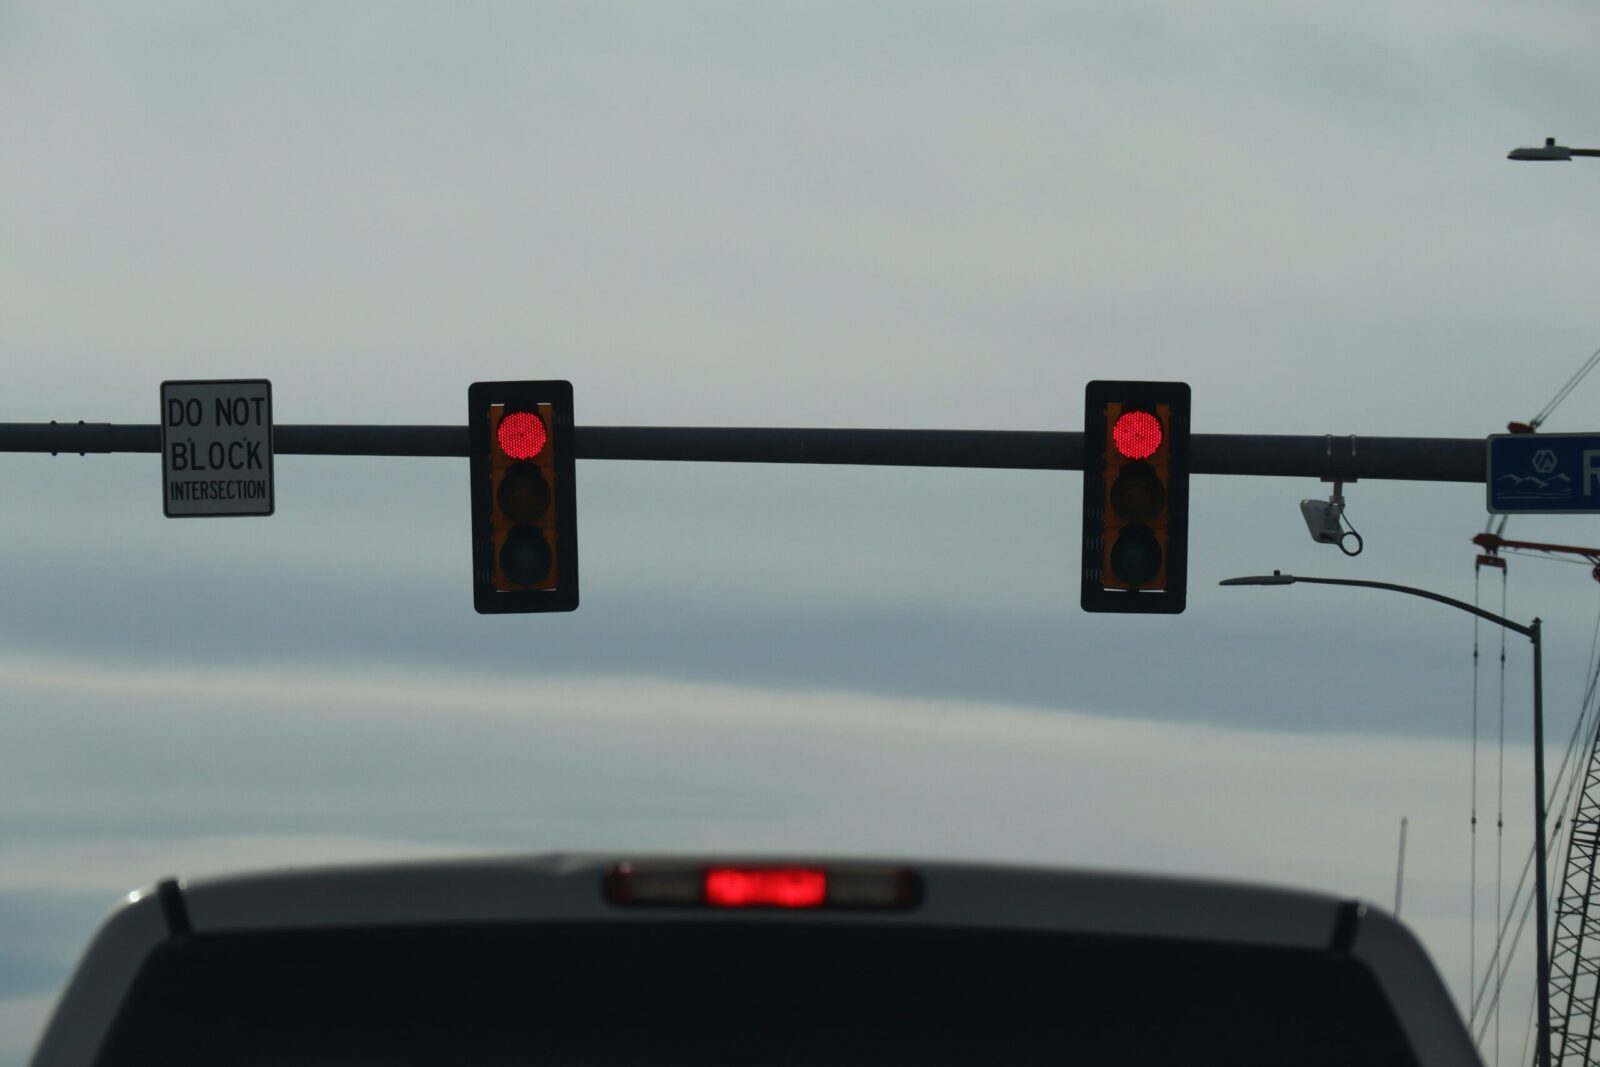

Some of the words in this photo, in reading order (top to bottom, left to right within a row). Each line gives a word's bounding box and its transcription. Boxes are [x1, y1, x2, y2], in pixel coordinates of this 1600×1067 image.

[168, 398, 202, 427] DO
[215, 397, 265, 427] NOT
[171, 441, 263, 471] BLOCK
[170, 480, 266, 501] INTERSECTION
